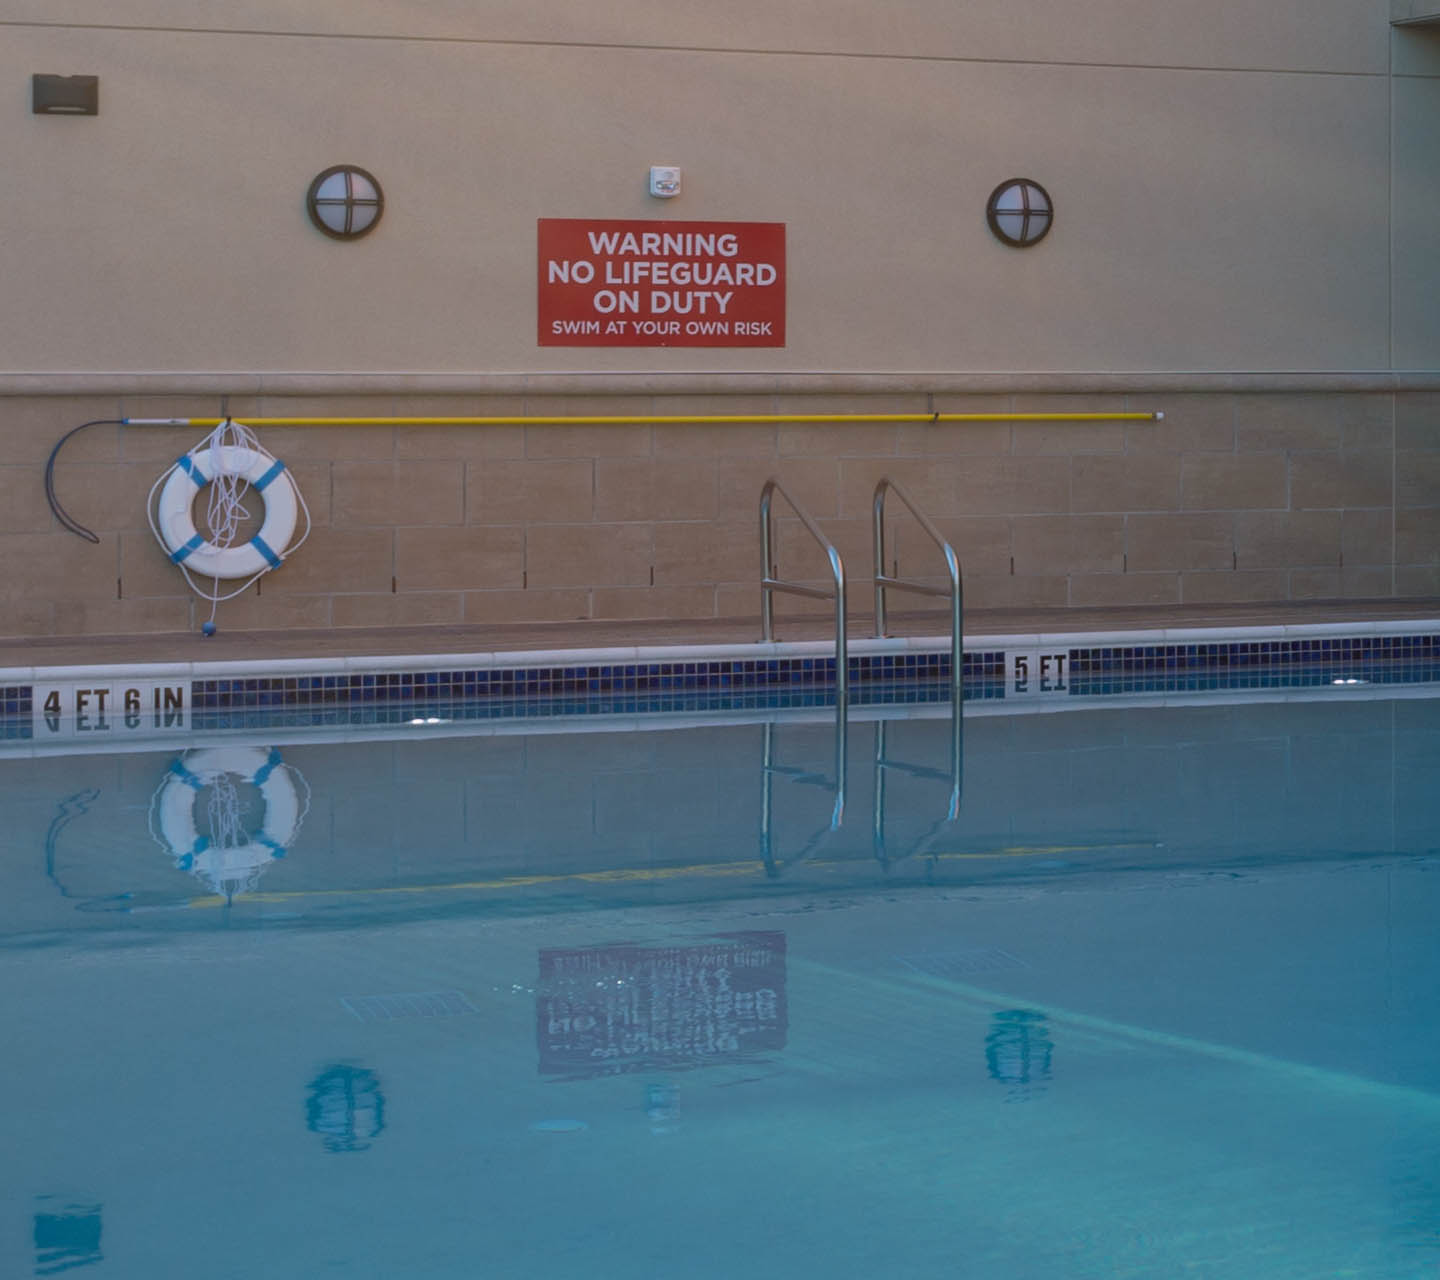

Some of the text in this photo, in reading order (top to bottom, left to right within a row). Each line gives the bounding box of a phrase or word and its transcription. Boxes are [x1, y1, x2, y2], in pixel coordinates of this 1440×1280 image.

[588, 232, 738, 257] WARNING
[548, 261, 777, 286] NO LIFEGUARD
[593, 290, 734, 314] ON DUTY
[552, 321, 773, 335] SWIM AT YOUR OWN RISK
[1040, 654, 1066, 676] FT
[43, 687, 183, 713] 4 FT 6 IN
